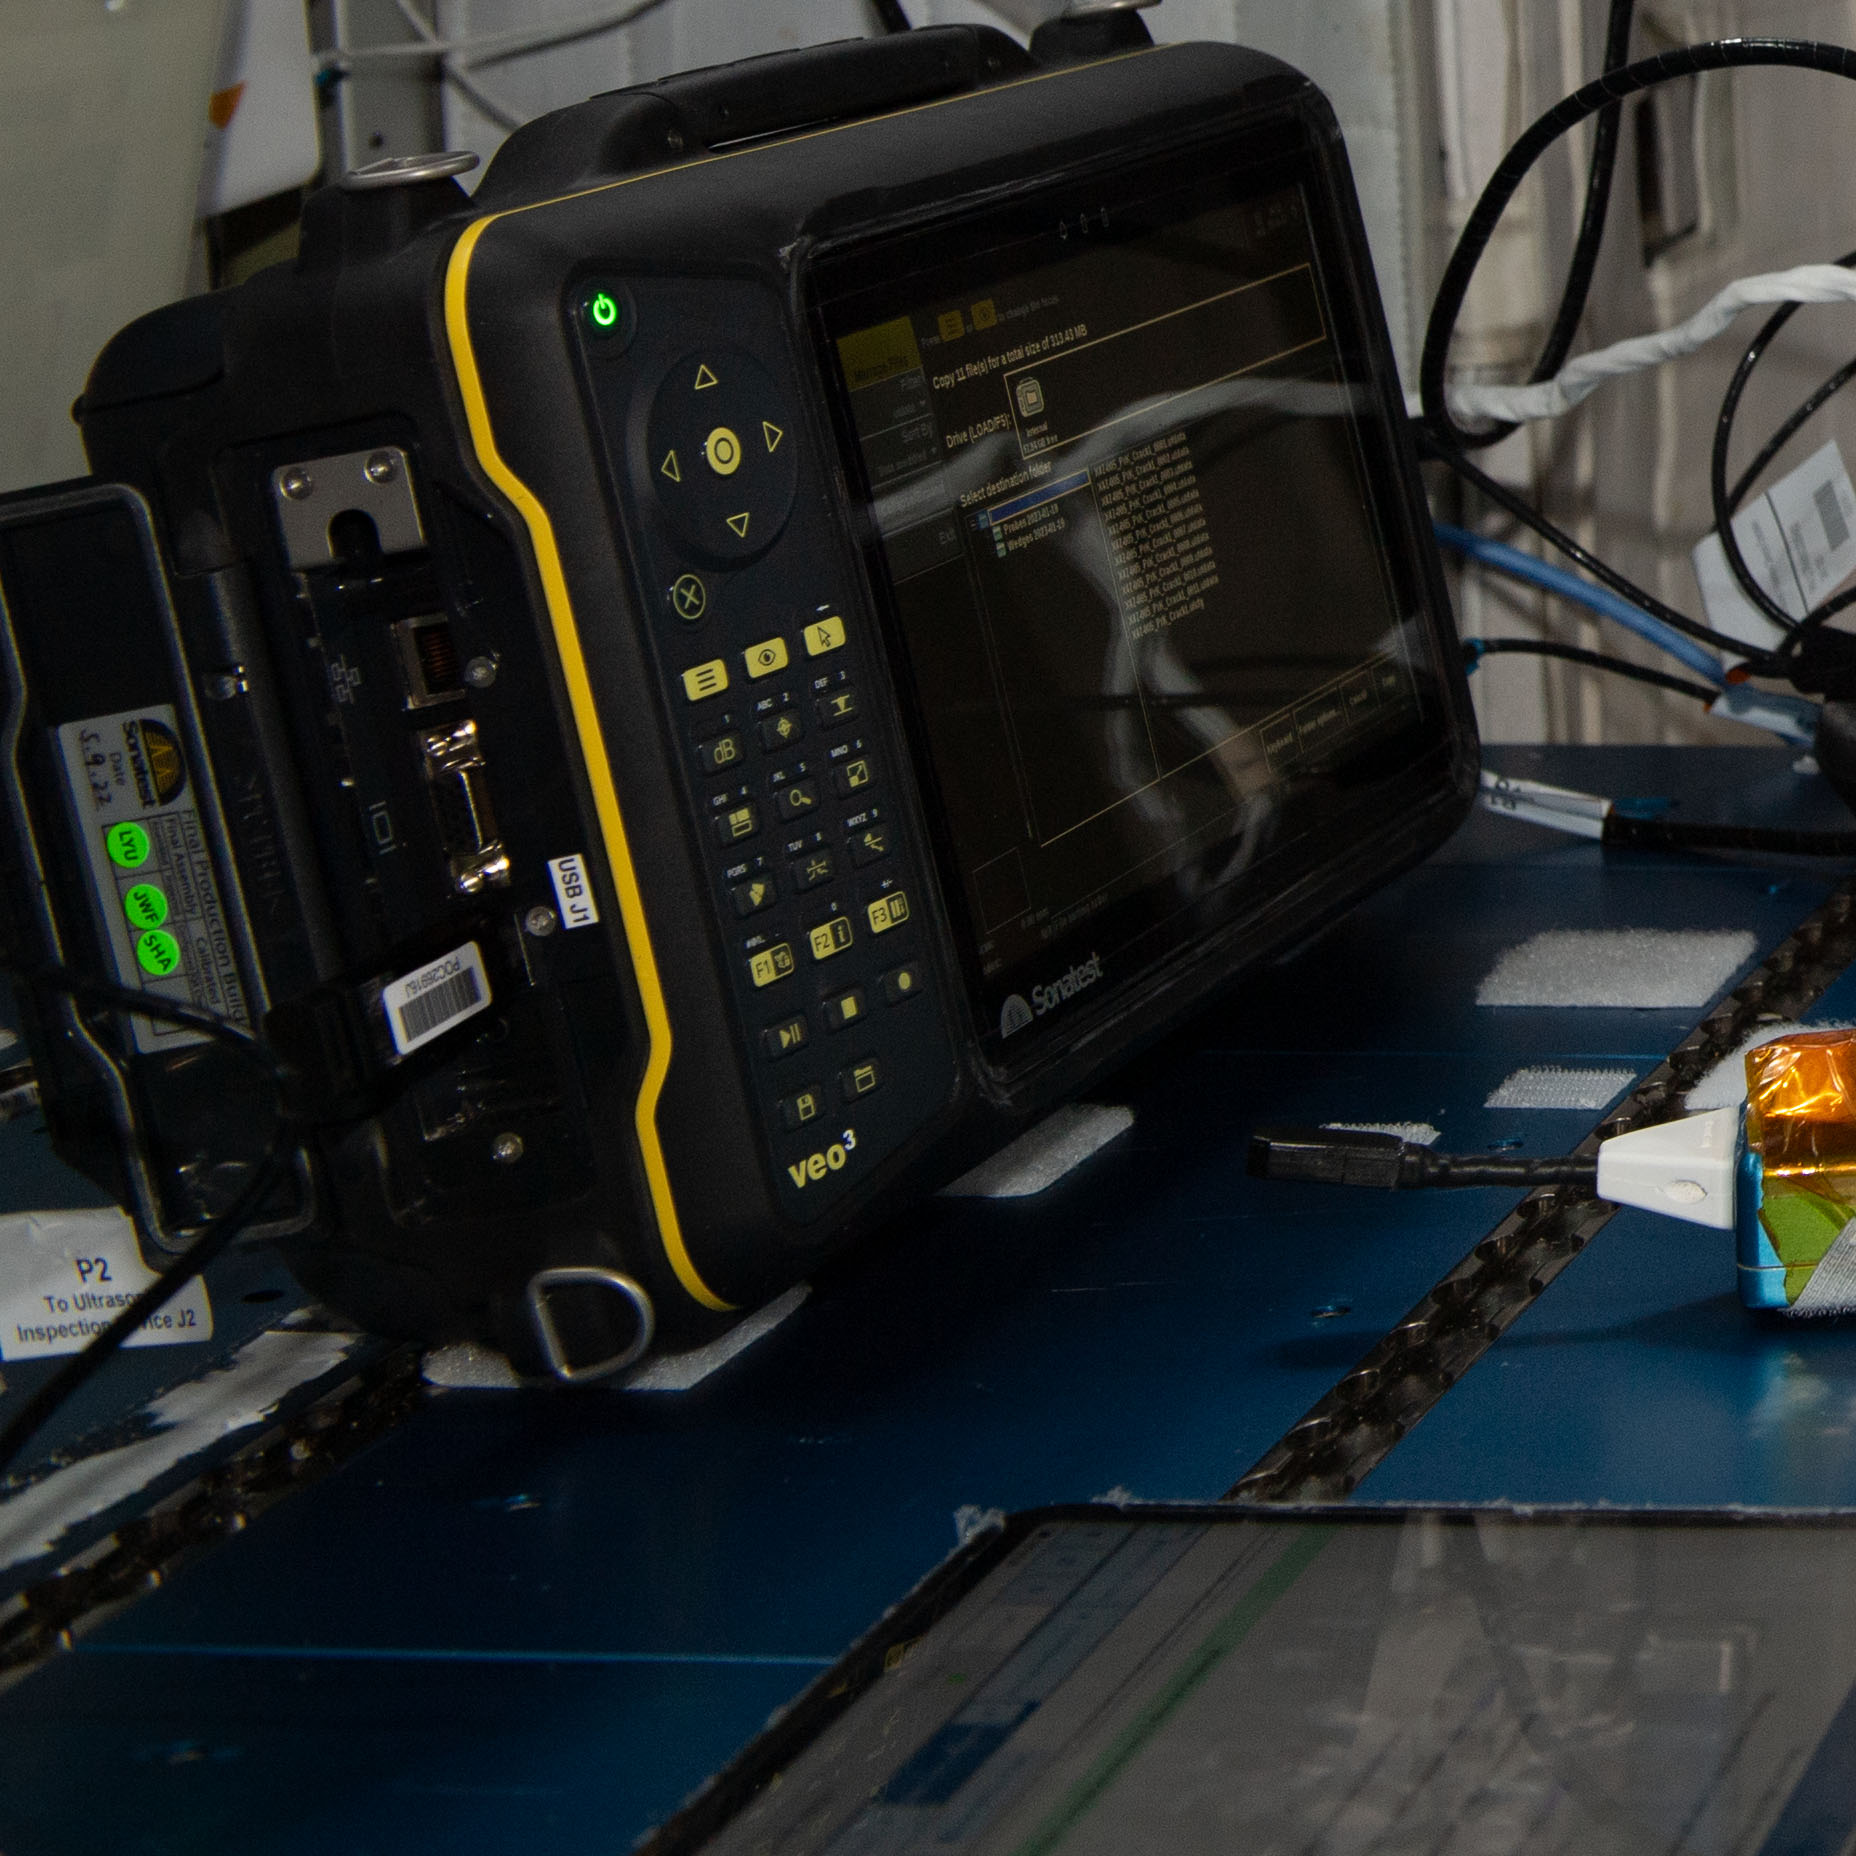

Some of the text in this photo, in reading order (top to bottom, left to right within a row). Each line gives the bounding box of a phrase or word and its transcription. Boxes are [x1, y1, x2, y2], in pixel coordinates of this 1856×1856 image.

[933, 374, 955, 390] Copy
[966, 357, 988, 380] file(s)
[988, 354, 1000, 370] for
[1006, 345, 1024, 363] total
[1025, 339, 1041, 357] size
[1041, 334, 1050, 351] of
[1073, 323, 1088, 340] MB
[946, 428, 968, 448] Drive
[960, 488, 986, 507] Select
[986, 470, 1029, 497] destination
[122, 721, 156, 808] Sonatest
[714, 738, 736, 765] dB
[118, 829, 138, 862] LYU
[165, 817, 182, 849] Final
[173, 853, 197, 916] Assembly
[181, 809, 199, 848] Final
[196, 858, 231, 975] Production
[558, 858, 590, 923] USB J1
[133, 890, 160, 925] JWF
[872, 907, 888, 925] F3
[144, 934, 172, 972] SHA
[814, 933, 830, 952] F2
[195, 937, 219, 1005] Calibrated
[755, 960, 772, 978] F1
[1031, 951, 1103, 1016] Sonatest
[76, 1257, 112, 1283] P2
[44, 1292, 139, 1313] To Ultraso
[178, 1309, 197, 1328] J2
